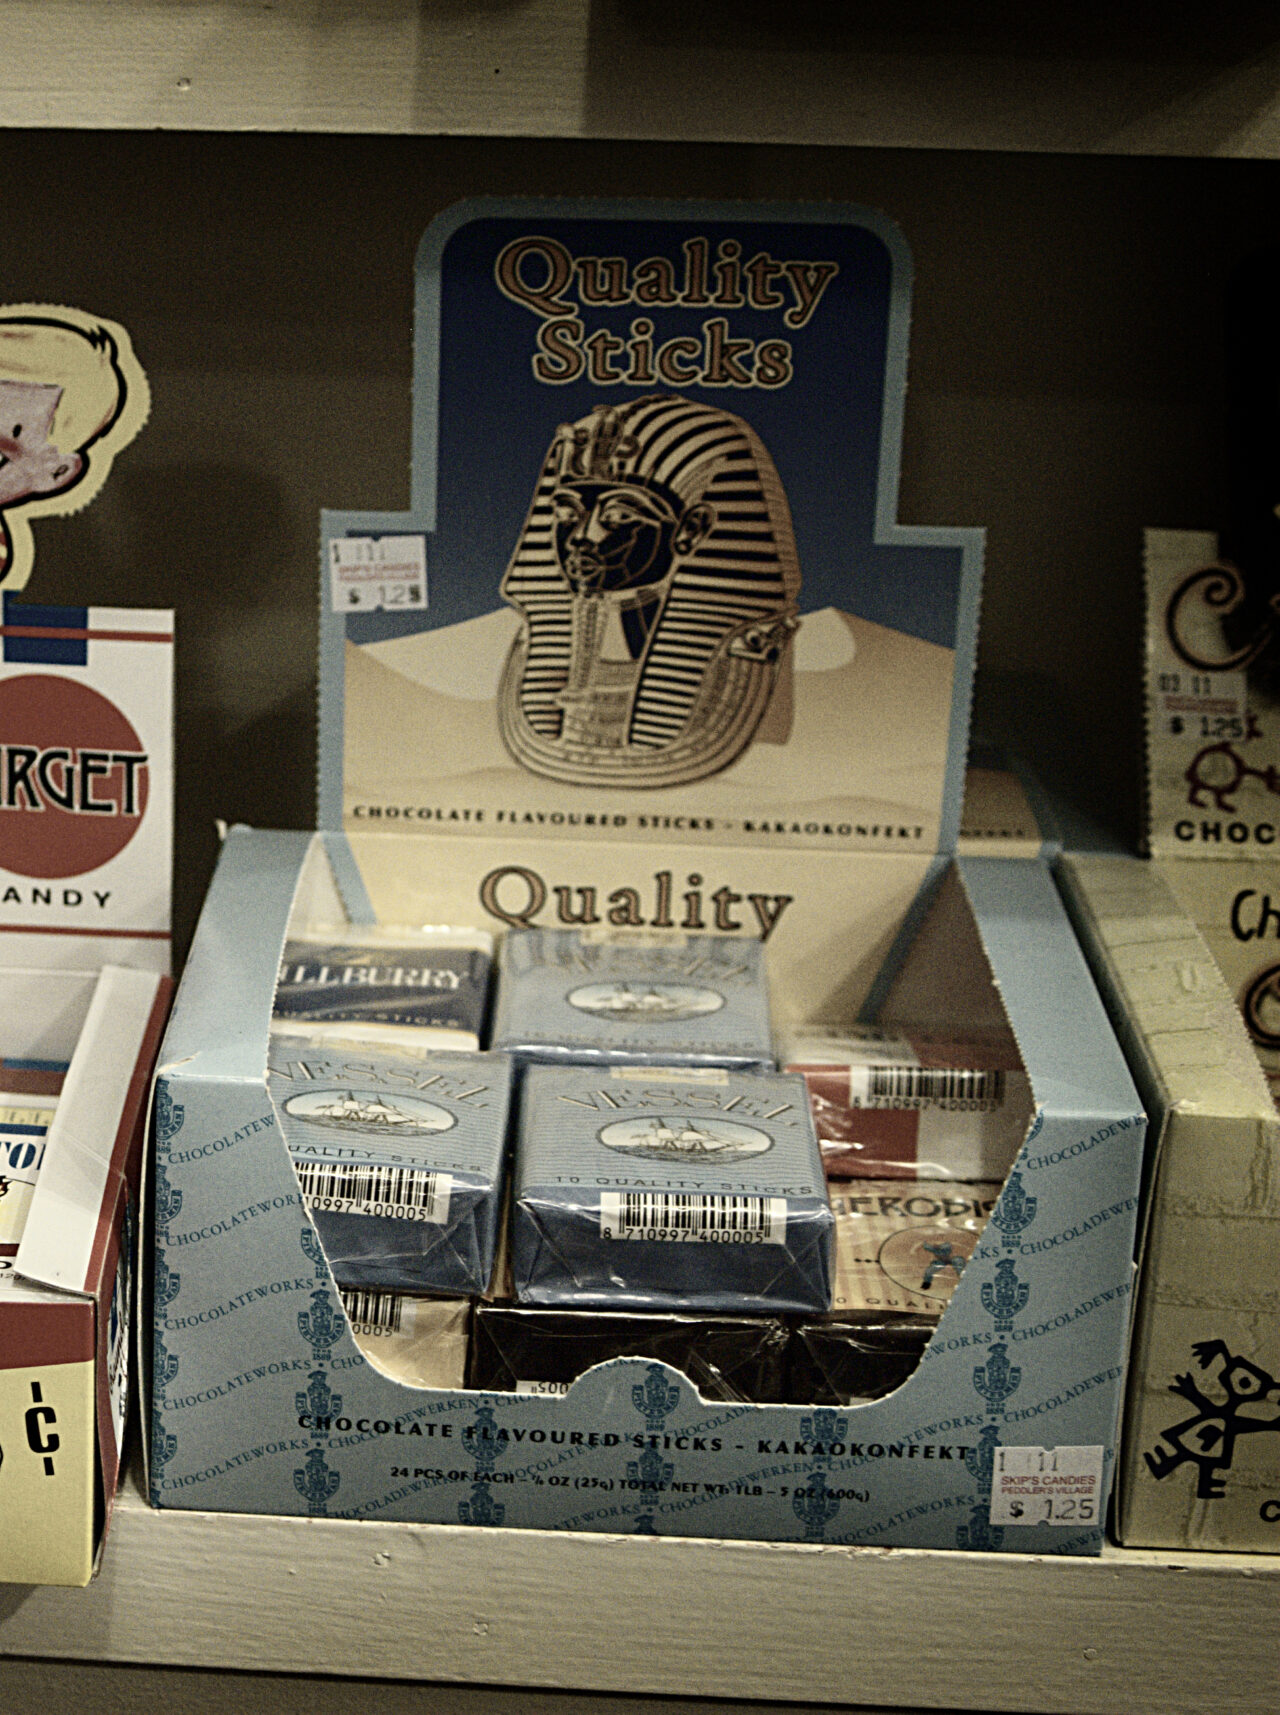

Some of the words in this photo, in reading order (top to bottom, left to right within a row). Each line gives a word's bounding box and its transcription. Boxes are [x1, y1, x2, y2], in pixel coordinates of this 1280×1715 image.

[495, 236, 839, 329] Quality
[532, 318, 793, 389] Sticks
[353, 805, 485, 823] CHOCOLATE
[497, 810, 627, 828] FLAVOURED
[639, 815, 715, 830] STICKS
[744, 820, 923, 838] KAKAOKONFEKT
[1174, 821, 1276, 844] CHOC
[480, 865, 793, 941] Quality
[596, 1177, 704, 1190] QUALITY
[721, 1182, 812, 1196] STICKS
[363, 1203, 427, 1221] 400005
[626, 1228, 690, 1243] 710997
[700, 1231, 764, 1245] 400005
[164, 1279, 314, 1331] CHOCOLATEWORKS
[163, 1360, 312, 1412] CHOCOLATEWORKS
[298, 1414, 454, 1439] CHOCOLATE
[465, 1425, 620, 1447] FLAVOURED
[632, 1433, 723, 1451] STICKS
[757, 1439, 968, 1459] KAKAOKONFEKT
[161, 1439, 309, 1491] CHOCOLATEWORKS
[391, 1466, 409, 1477] 24
[414, 1468, 443, 1479] PCS
[447, 1471, 472, 1481] OF
[473, 1472, 515, 1484] EACH
[548, 1476, 570, 1487] OZ
[574, 1477, 614, 1491] (25g)
[619, 1479, 666, 1491] TOTAL
[671, 1482, 699, 1493] NET
[1001, 1475, 1040, 1486] SKIP'S
[1043, 1475, 1096, 1486] CANDIES
[1044, 1499, 1094, 1520] 1.25
